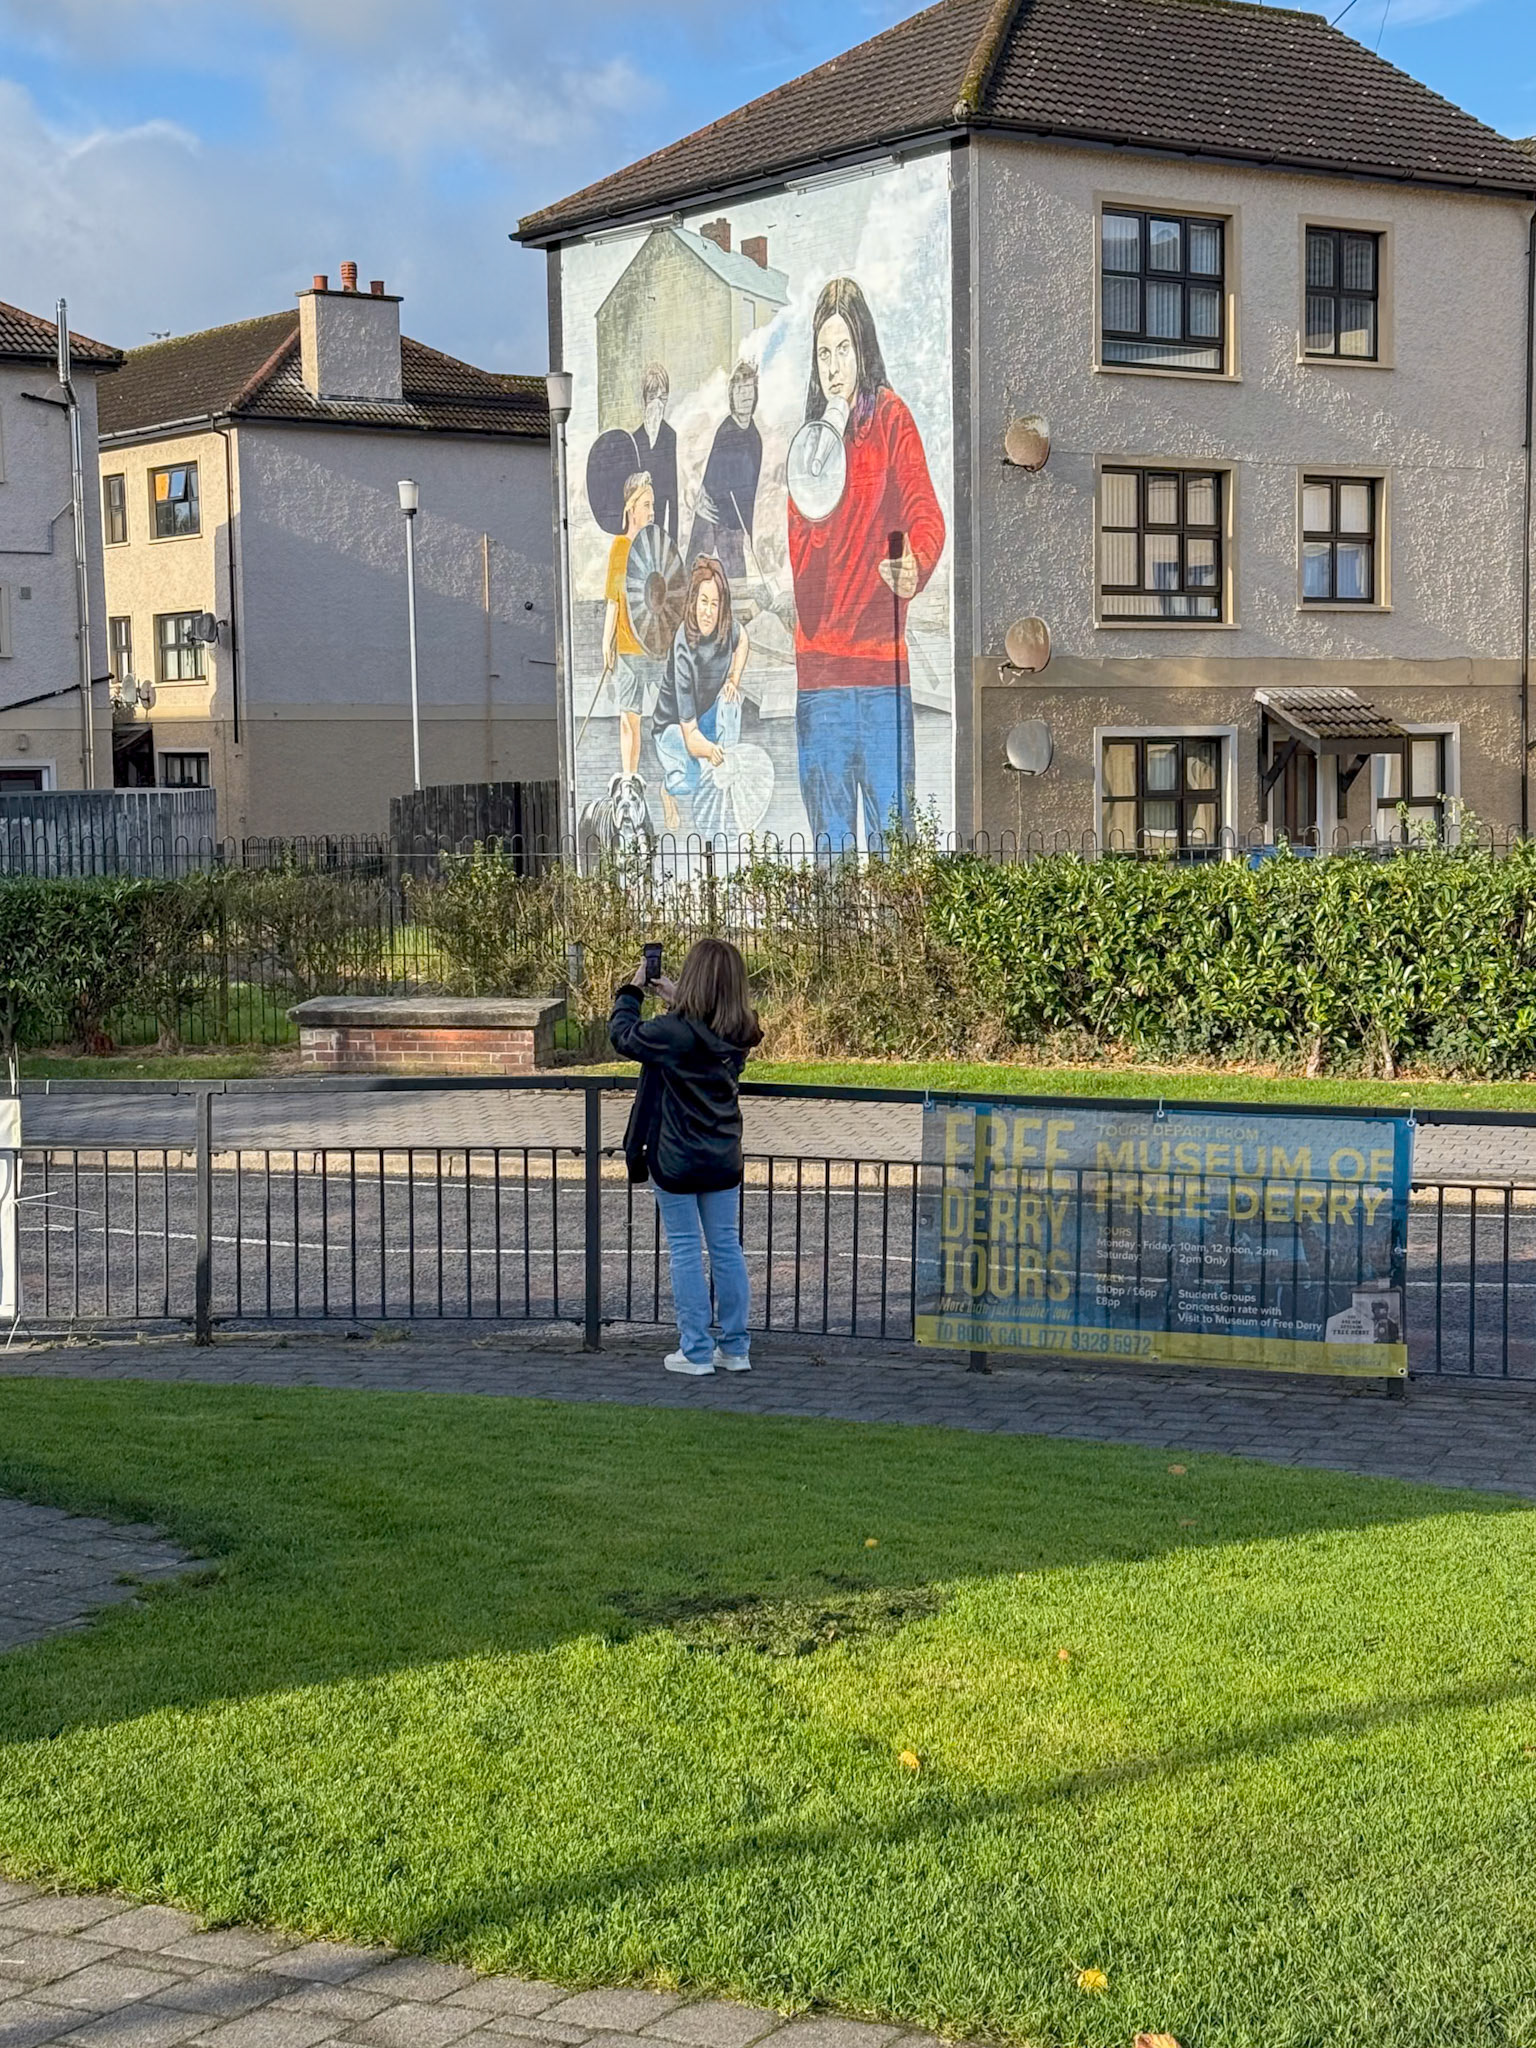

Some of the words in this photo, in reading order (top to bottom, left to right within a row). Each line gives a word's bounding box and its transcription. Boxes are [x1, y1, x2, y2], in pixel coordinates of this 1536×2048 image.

[1098, 1123, 1148, 1137] TOURS
[1153, 1123, 1211, 1138] DEPART
[1216, 1126, 1259, 1141] FROM
[945, 1112, 1075, 1189] FREE
[1096, 1140, 1311, 1180] MUSEUM
[1329, 1147, 1394, 1187] OF
[1096, 1179, 1211, 1219] FREE
[1228, 1183, 1387, 1226] DERRY
[941, 1187, 1070, 1246] DERRY
[1098, 1226, 1132, 1237] TOURS
[1097, 1239, 1136, 1251] Monday
[1179, 1242, 1209, 1253] 10am,
[1212, 1243, 1223, 1253] 12
[1256, 1246, 1279, 1258] 2pm
[1179, 1254, 1202, 1265] 2pm
[1204, 1255, 1228, 1267] Only
[939, 1241, 1071, 1302] TOURS
[1096, 1284, 1125, 1297] £10pp
[1132, 1287, 1157, 1299] £6pp
[1178, 1289, 1218, 1300] Student
[1220, 1292, 1257, 1303] Groups
[939, 1297, 964, 1313] More
[1096, 1296, 1121, 1309] £8pp
[1178, 1301, 1236, 1313] Concession
[1238, 1306, 1258, 1315] rate
[1261, 1307, 1282, 1317] with
[1177, 1313, 1200, 1323] Visit
[1202, 1314, 1213, 1323] to
[1215, 1315, 1258, 1326] Museum
[1260, 1317, 1271, 1327] of
[1273, 1318, 1294, 1329] Free
[1296, 1320, 1322, 1333] Derry
[936, 1321, 953, 1342] TO
[957, 1323, 992, 1345] BOOK
[998, 1326, 1033, 1347] CALL
[1039, 1329, 1067, 1350] 077
[1071, 1332, 1110, 1353] 9328
[1113, 1334, 1151, 1356] 5972
